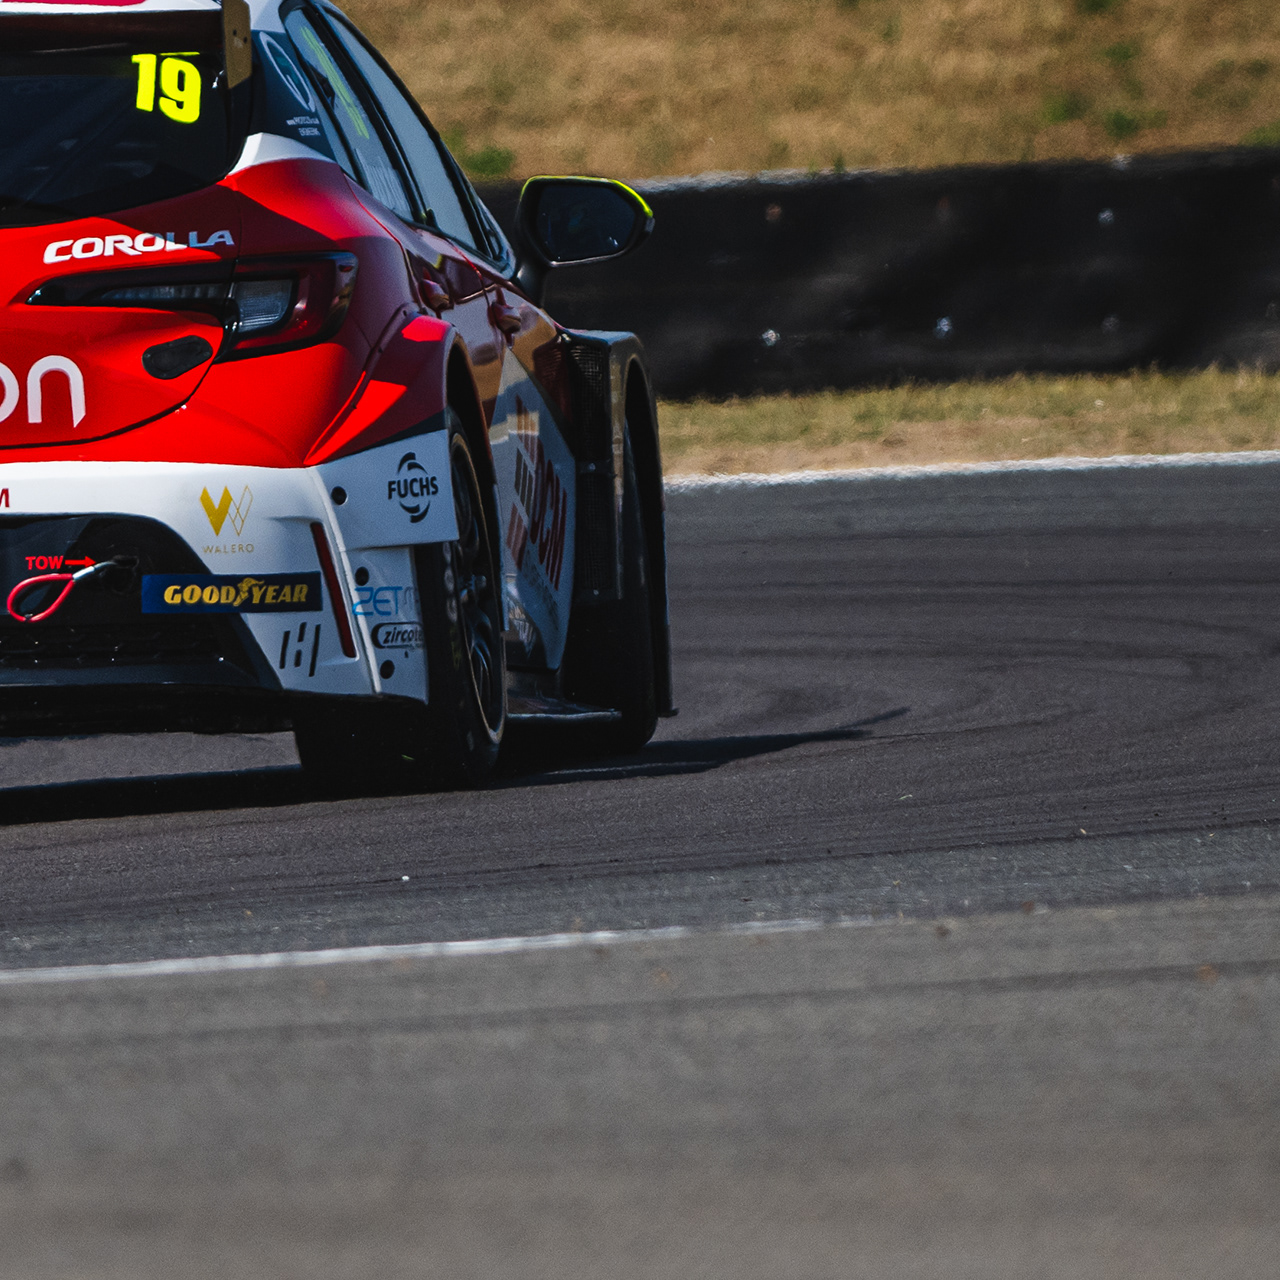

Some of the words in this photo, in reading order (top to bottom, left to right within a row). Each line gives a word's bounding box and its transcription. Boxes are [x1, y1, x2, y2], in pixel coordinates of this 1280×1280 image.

[131, 52, 202, 124] 19
[42, 230, 235, 265] COROLLA
[387, 476, 439, 500] FUCHS
[202, 542, 255, 555] WALERO
[25, 555, 65, 571] TOW
[163, 578, 309, 607] GOODYEAR
